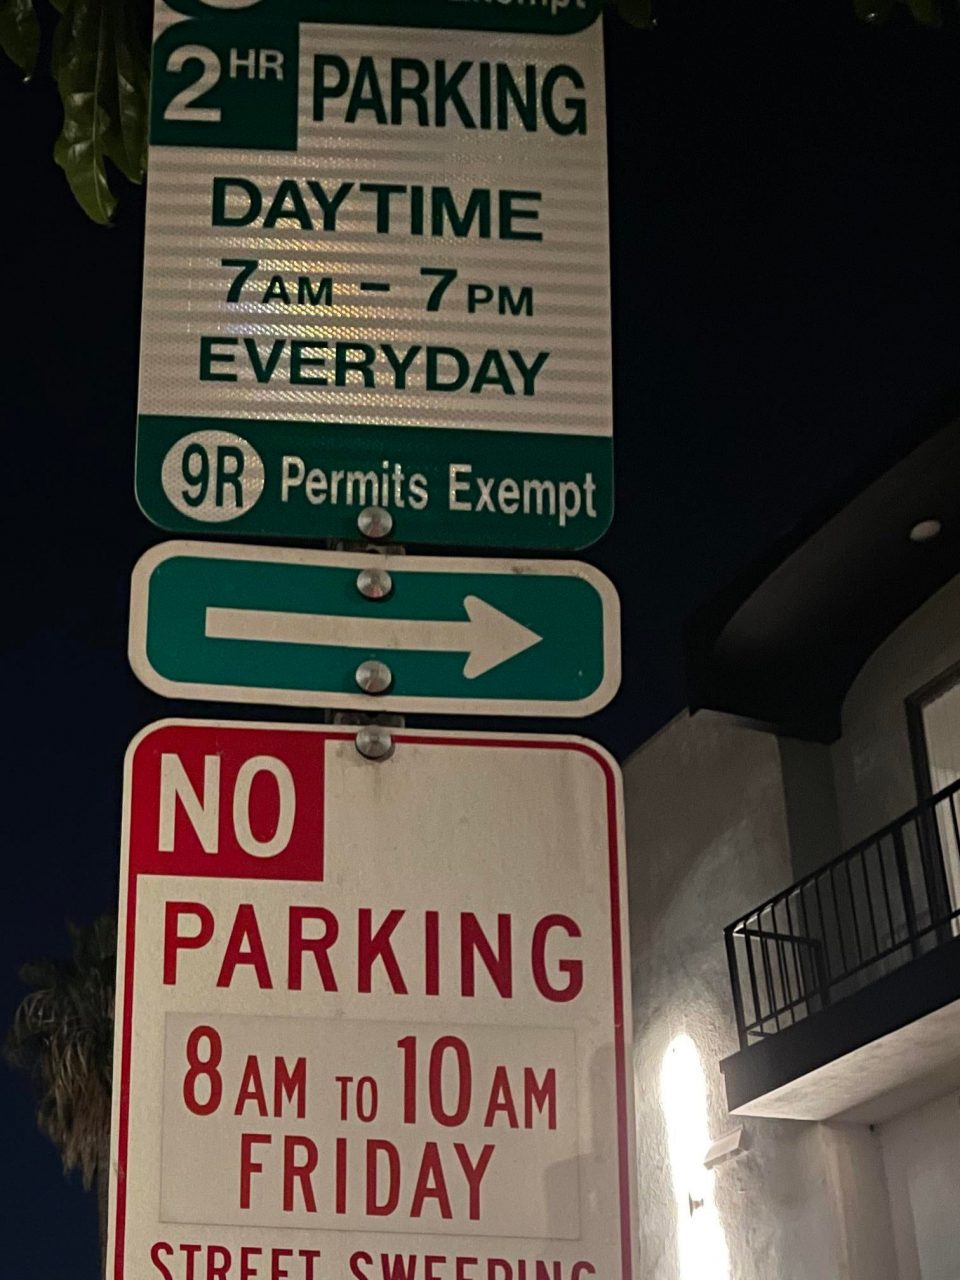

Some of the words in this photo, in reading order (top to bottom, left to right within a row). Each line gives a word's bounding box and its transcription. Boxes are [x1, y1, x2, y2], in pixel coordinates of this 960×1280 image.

[312, 53, 588, 137] PARKING
[210, 176, 544, 242] DAYTIME
[198, 336, 550, 397] EVERYDAY
[180, 442, 246, 510] 9R
[281, 455, 429, 511] Permits
[448, 463, 597, 526] Exempt
[157, 752, 297, 859] NO
[161, 900, 585, 1004] PARKING
[335, 1076, 379, 1123] TO
[239, 1132, 497, 1222] FRIDAY
